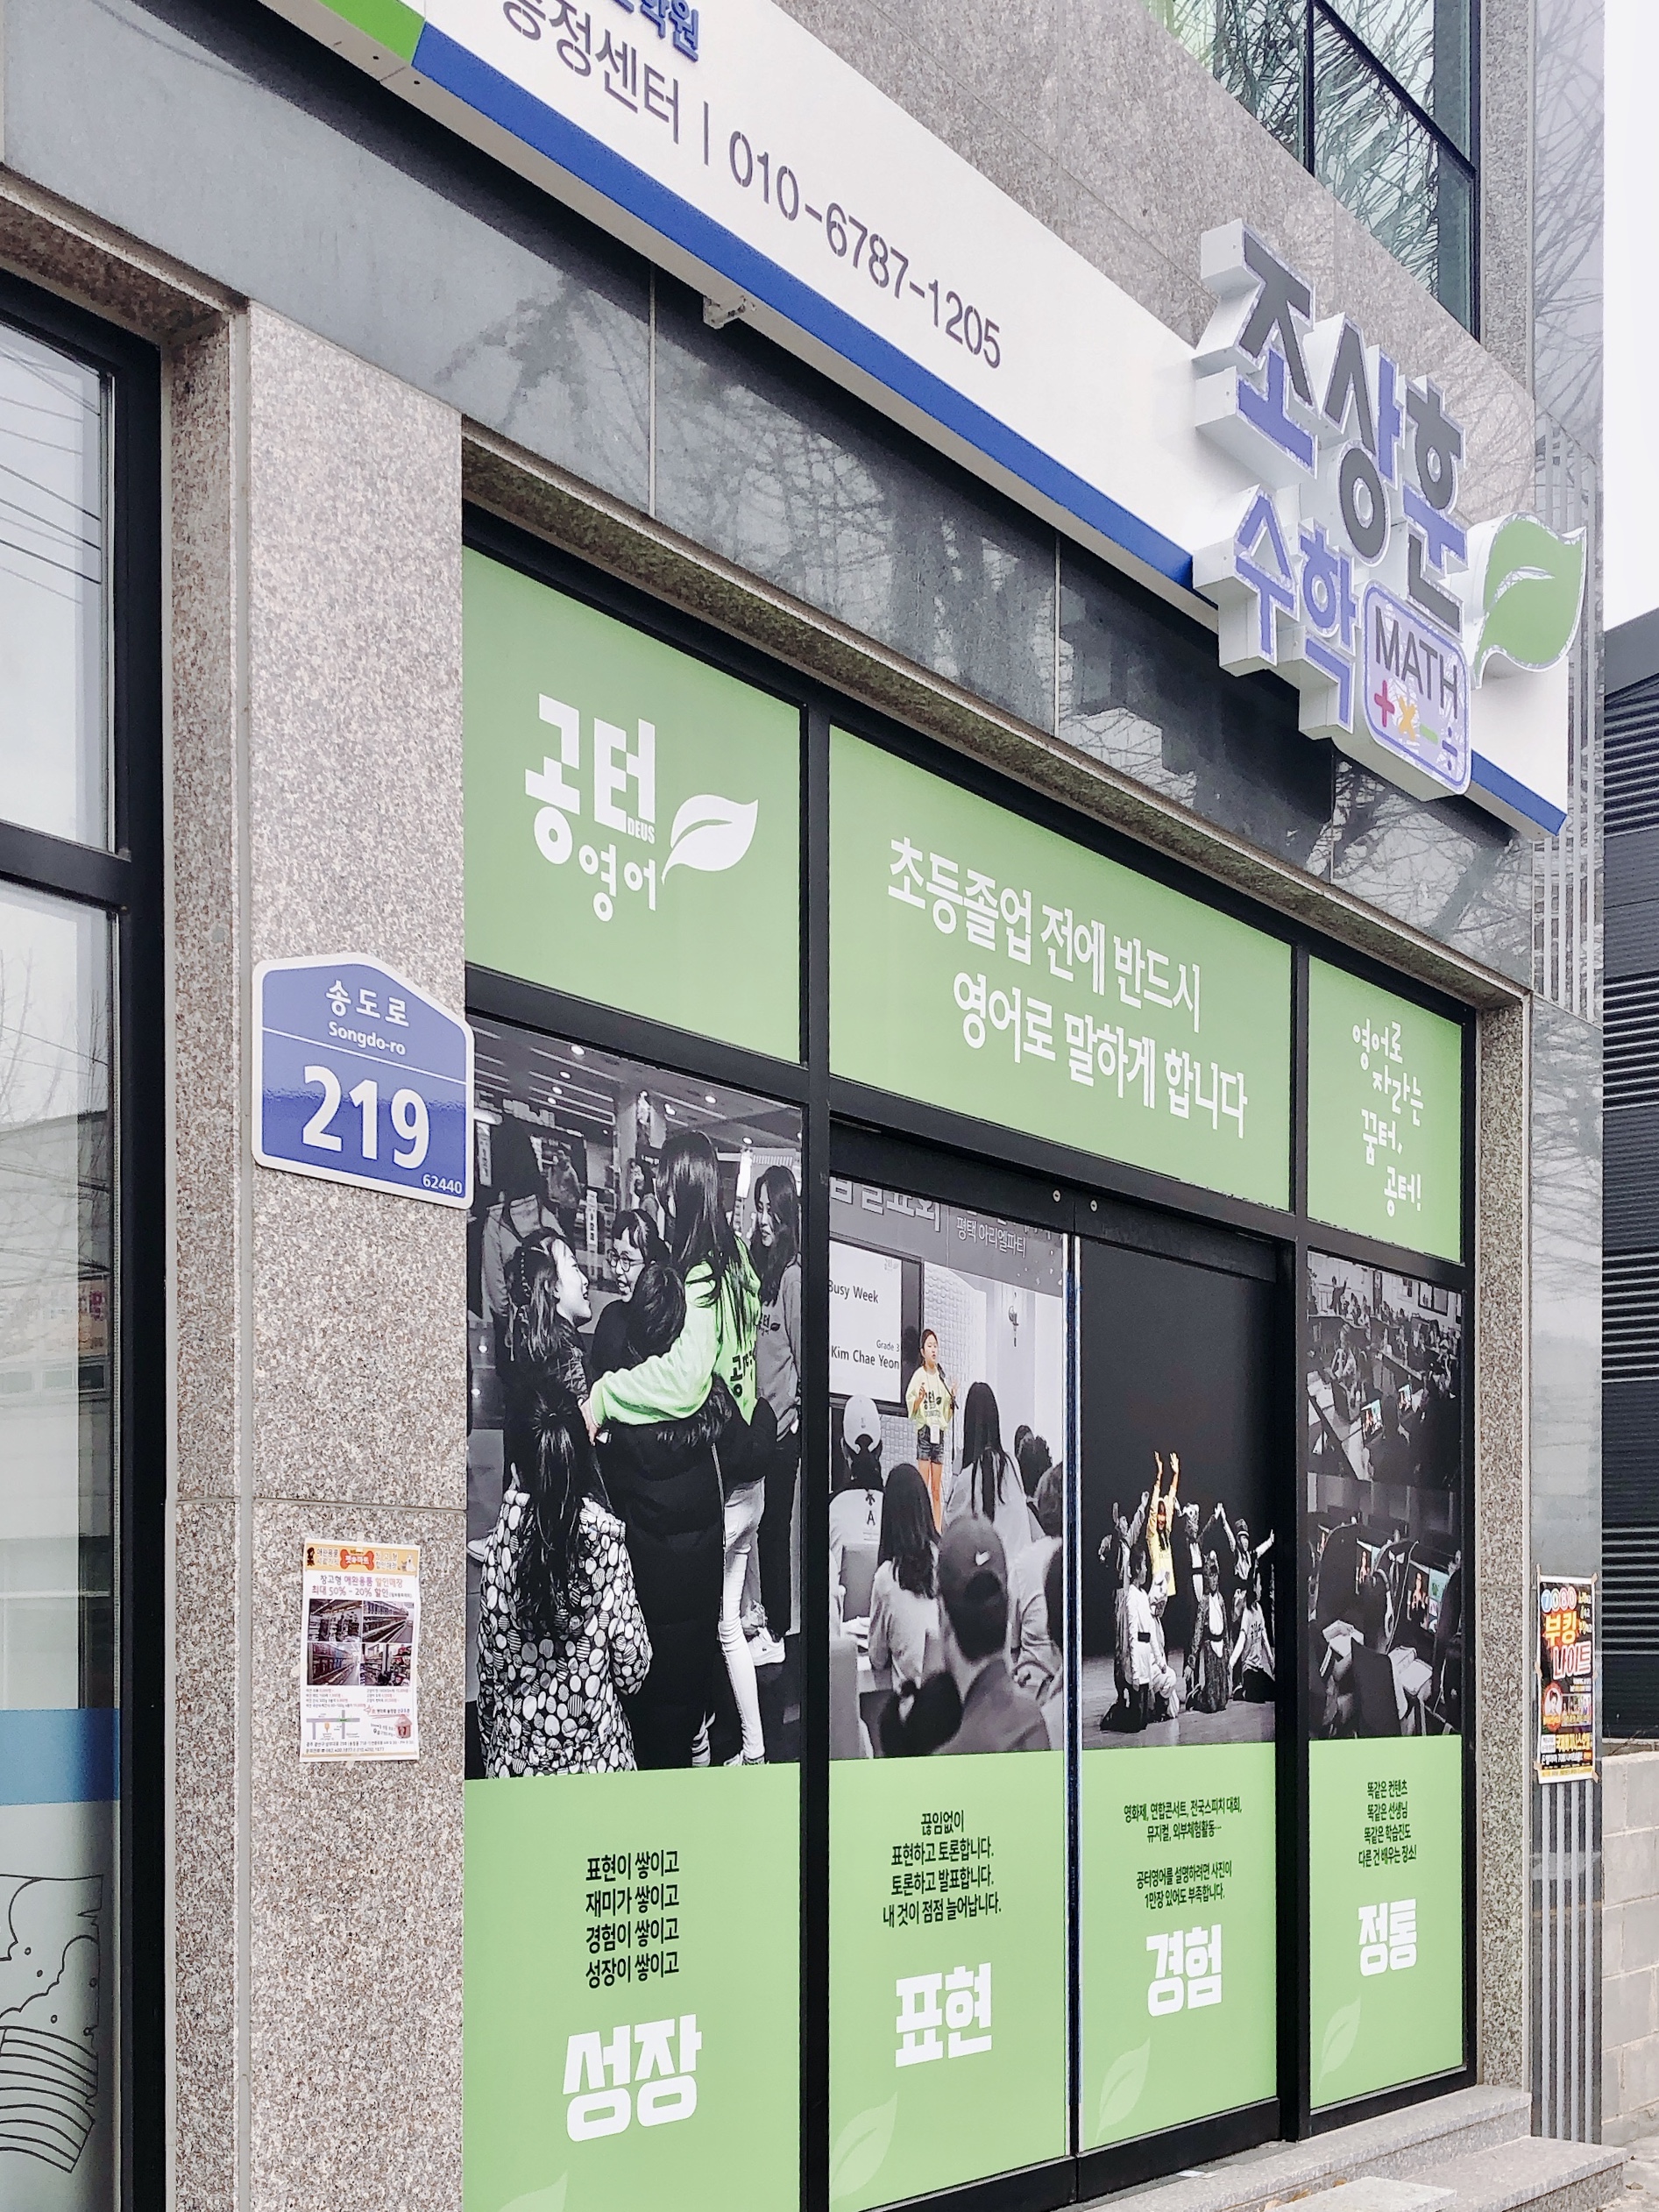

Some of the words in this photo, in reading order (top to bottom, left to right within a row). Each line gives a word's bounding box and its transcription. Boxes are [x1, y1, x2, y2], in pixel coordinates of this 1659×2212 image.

[729, 131, 1001, 369] 010-6787-1205
[1235, 228, 1468, 637] 조상훈
[1234, 489, 1357, 736] 수학
[1375, 606, 1458, 719] MATH
[525, 692, 656, 865] 공터
[627, 817, 656, 845] DEUS
[578, 843, 656, 922] 영어
[888, 836, 1032, 966] 초등졸업
[1040, 904, 1105, 996] 전에
[1113, 934, 1200, 1033] 반드시
[326, 980, 409, 1027] 송도로
[328, 1020, 406, 1056] Songdo-ro
[953, 971, 1056, 1064] 영어로
[1064, 1012, 1156, 1110] 말하게
[1164, 1048, 1248, 1139] 합니다
[1352, 1017, 1403, 1071] 영어로
[1372, 1064, 1424, 1127] 자라는
[302, 1065, 430, 1169] 219
[1361, 1108, 1402, 1166] 꿈터,
[422, 1173, 463, 1195] 62440
[1384, 1165, 1421, 1217] 공터!
[829, 1280, 850, 1300] Busy
[853, 1285, 879, 1304] Week
[831, 1345, 849, 1360] Kim
[853, 1350, 876, 1365] Chae
[878, 1354, 900, 1370] Yeon
[876, 1339, 895, 1351] Grade
[897, 1344, 900, 1352] 3
[312, 1585, 327, 1594] 최대
[1367, 1780, 1387, 1799] 똑같은
[1388, 1779, 1408, 1797] 컨텐츠
[920, 1810, 964, 1836] 끊임없이
[1124, 1803, 1149, 1823] 영화제,
[1150, 1801, 1189, 1821] 연합콘서트,
[1190, 1797, 1225, 1817] 전국스피치
[1367, 1803, 1387, 1822] 똑같은
[1388, 1800, 1408, 1820] 선생님
[891, 1841, 936, 1867] 표현하고
[938, 1835, 995, 1862] 토론합니다.
[1147, 1824, 1172, 1843] 뮤지컬,
[1364, 1826, 1385, 1845] 똑같은
[1385, 1823, 1412, 1842] 학습진도
[585, 1852, 631, 1882] 표현이
[635, 1849, 679, 1879] 쌓이고
[1136, 1867, 1173, 1889] 공터영어를
[1174, 1862, 1210, 1884] 설명하려면
[1211, 1860, 1232, 1878] 사진이
[1358, 1849, 1372, 1868] 다른
[1372, 1847, 1380, 1867] 건
[1380, 1846, 1401, 1865] 배우는
[891, 1871, 936, 1897] 토론하고
[939, 1864, 995, 1893] 발표합니다.
[1145, 1890, 1165, 1910] 1만장
[1165, 1888, 1187, 1907] 있어도
[1188, 1882, 1225, 1904] 부족합니다.
[585, 1886, 632, 1918] 재미가
[635, 1882, 679, 1913] 쌓이고
[883, 1904, 895, 1928] 내
[897, 1901, 919, 1926] 것이
[922, 1897, 944, 1924] 점점
[946, 1891, 1002, 1921] 늘어납니다.
[585, 1920, 631, 1954] 경험이
[635, 1917, 679, 1947] 쌓이고
[1358, 1897, 1417, 1977] 정통
[585, 1954, 631, 1989] 성장이
[635, 1950, 679, 1982] 쌓이고
[1145, 1924, 1223, 2017] 경험
[896, 1962, 992, 2068] 표현
[563, 2014, 702, 2142] 성장
